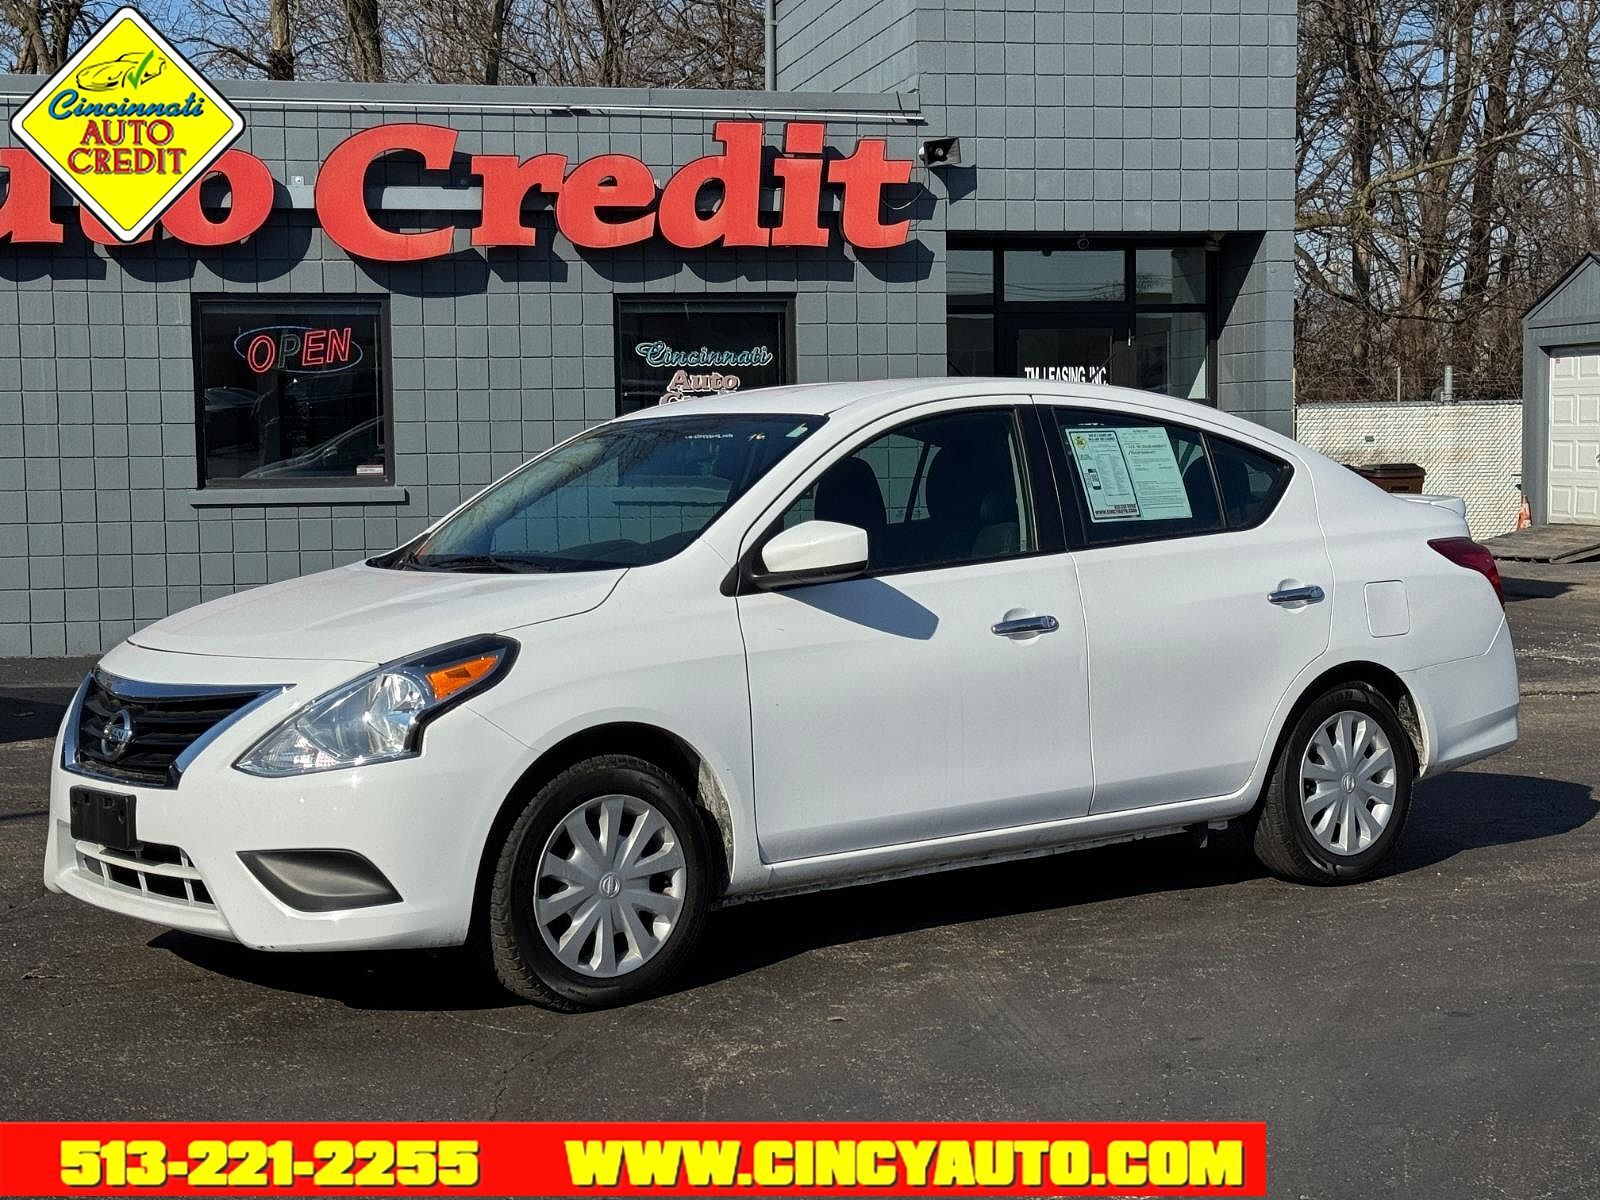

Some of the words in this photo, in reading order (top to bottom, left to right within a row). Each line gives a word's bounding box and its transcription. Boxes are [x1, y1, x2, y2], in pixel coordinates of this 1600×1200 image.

[314, 120, 914, 262] Credit
[248, 328, 351, 373] OPEN
[635, 341, 773, 368] Cincinnati
[667, 369, 740, 393] Auto
